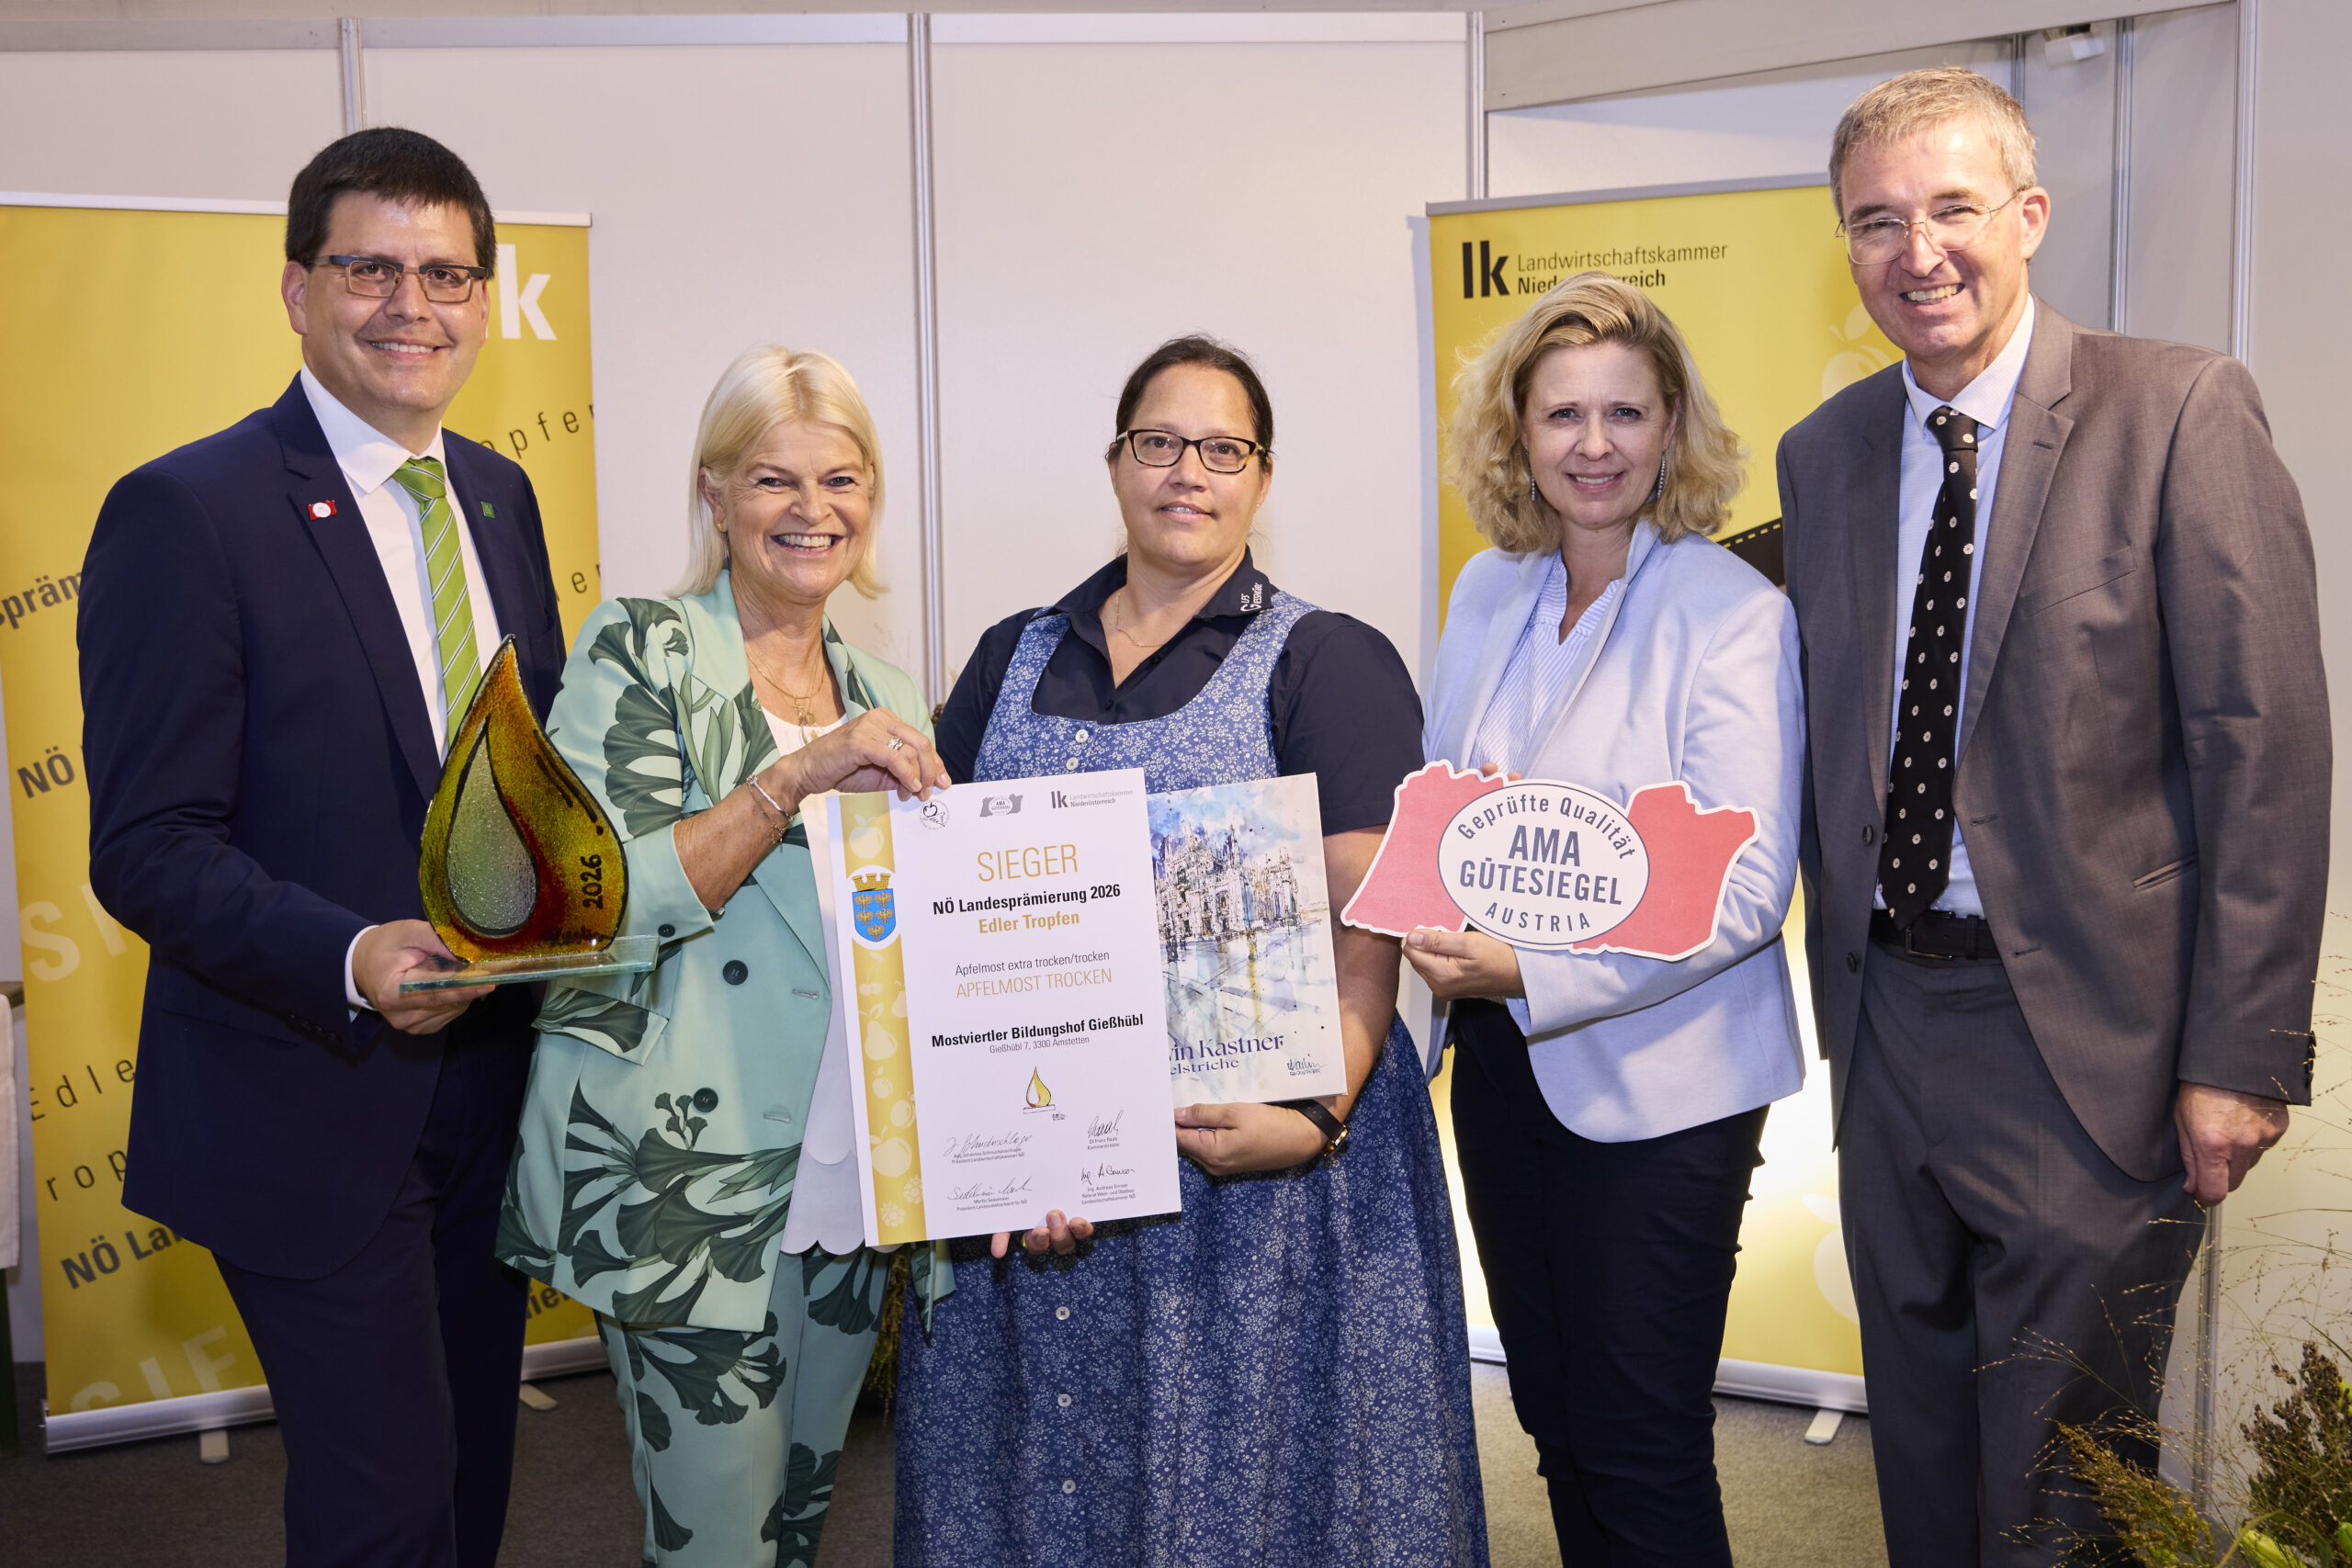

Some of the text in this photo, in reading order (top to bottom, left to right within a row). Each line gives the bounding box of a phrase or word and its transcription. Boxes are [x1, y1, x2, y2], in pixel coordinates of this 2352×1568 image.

[1462, 240, 1510, 299] lk
[1517, 244, 1728, 273] Landwirtschaftskammer
[485, 243, 557, 341] k
[0, 571, 82, 630] präm
[17, 745, 75, 799] NÖ
[1051, 790, 1069, 808] lk
[1069, 789, 1134, 801] Landwirtschaftskammer
[1069, 797, 1116, 807] Niederösterreich
[1457, 794, 1635, 860] Geprüfte Qualität
[1508, 825, 1580, 867] AMA
[978, 844, 1079, 882] SIEGER
[580, 853, 604, 909] 2026
[933, 884, 1121, 915] NÖ Landesprämierung 2026
[978, 911, 1080, 933] Edler Tropfen
[1485, 902, 1590, 932] AUSTRIA
[956, 951, 1110, 977] Apfelmost extra trocken/trocken
[956, 968, 1113, 998] APFELMOST TROCKEN
[932, 1014, 1144, 1047] Mostviertler Bildungshof Gießhübl
[989, 1036, 1090, 1054] Gießhübl 7, 3300 Amstetten
[1199, 1035, 1284, 1058] Kastner
[61, 1235, 120, 1290] NÖ
